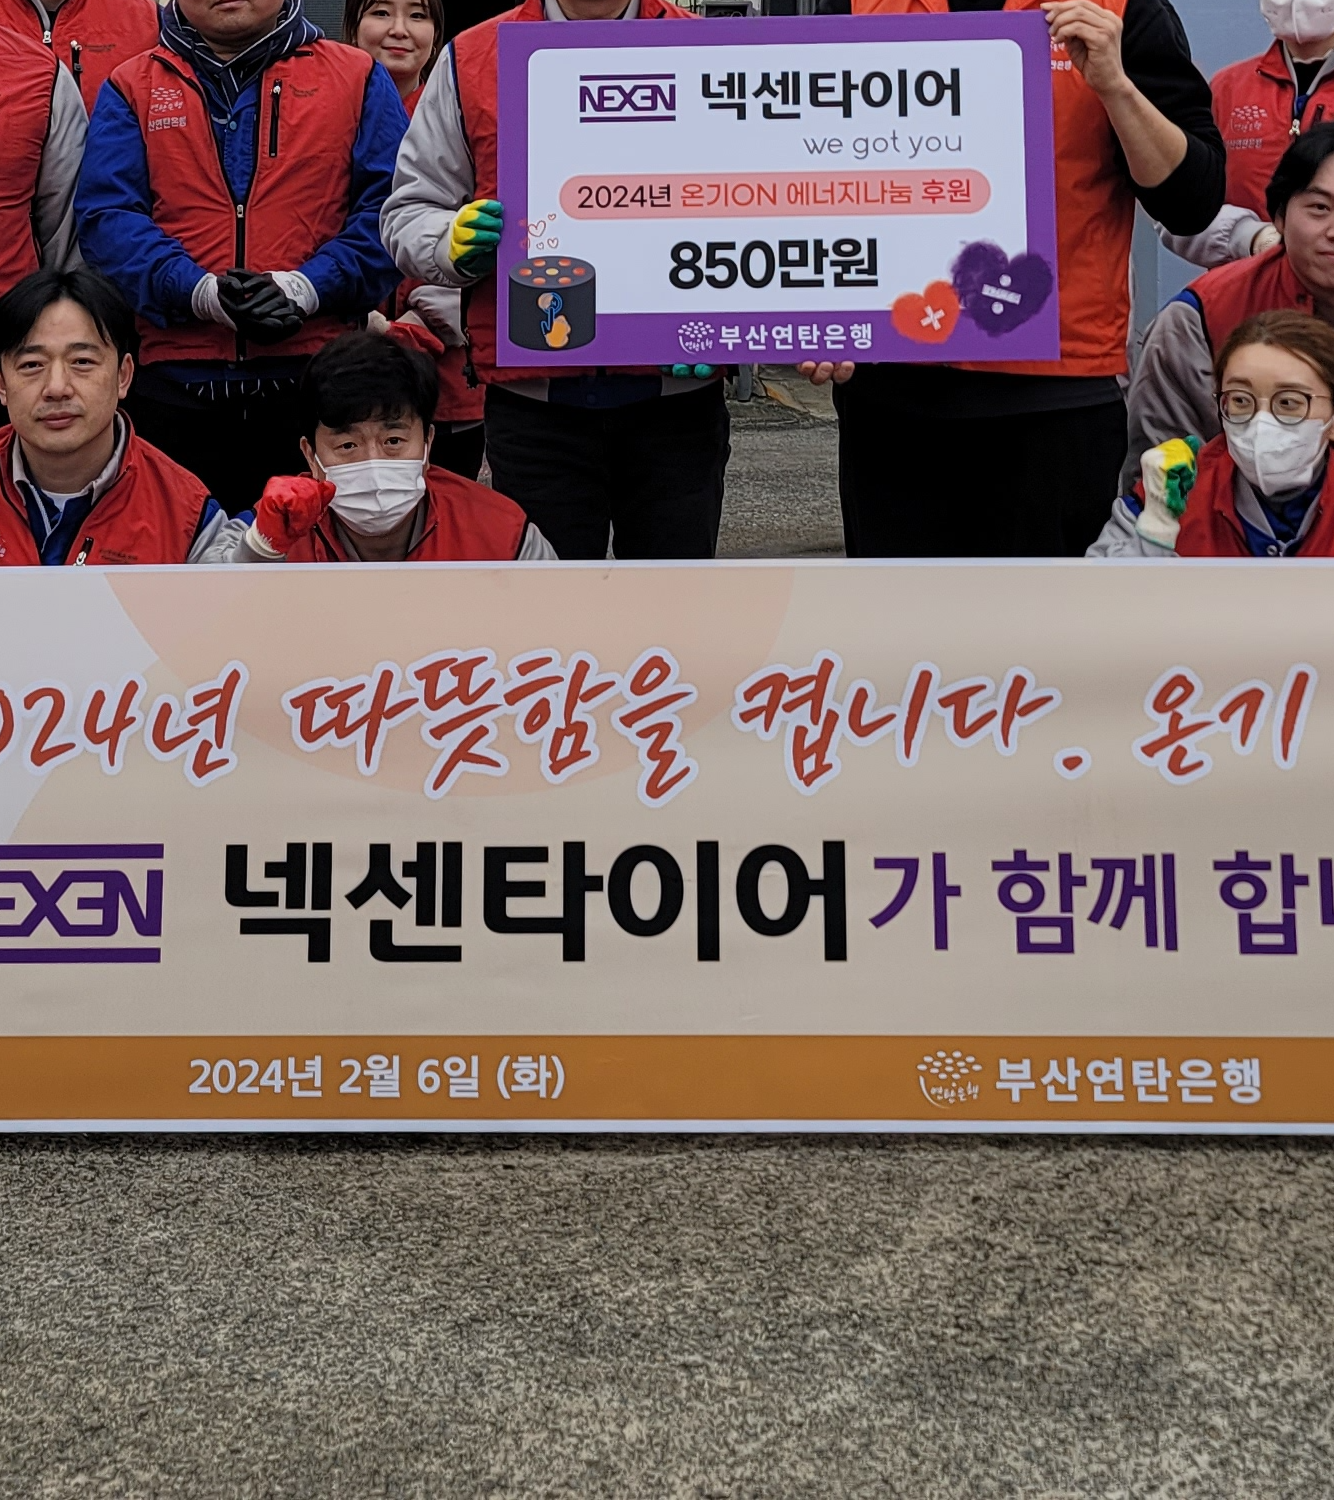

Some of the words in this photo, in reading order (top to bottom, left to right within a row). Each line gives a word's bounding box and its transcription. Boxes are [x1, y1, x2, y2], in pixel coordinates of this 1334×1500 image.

[579, 83, 677, 113] NEXEN
[701, 67, 961, 121] 넥센타이어
[802, 137, 844, 155] we
[852, 129, 901, 160] got
[908, 132, 962, 160] you
[577, 183, 672, 209] 2024년
[680, 182, 777, 208] 온기ON
[786, 180, 913, 206] 에너지나눔
[921, 178, 972, 205] 후원
[668, 237, 879, 290] 850만원
[719, 323, 872, 351] 부산연탄은행
[290, 655, 691, 800] 따뜻함을
[739, 658, 1083, 787] 켭니다.
[1141, 672, 1312, 776] 온기
[991, 848, 1179, 955] 함께
[188, 1056, 323, 1098] 2024년
[339, 1055, 401, 1098] 2월
[417, 1055, 480, 1099] 6일
[496, 1055, 566, 1100] (화)
[995, 1056, 1262, 1104] 부산연탄은행
